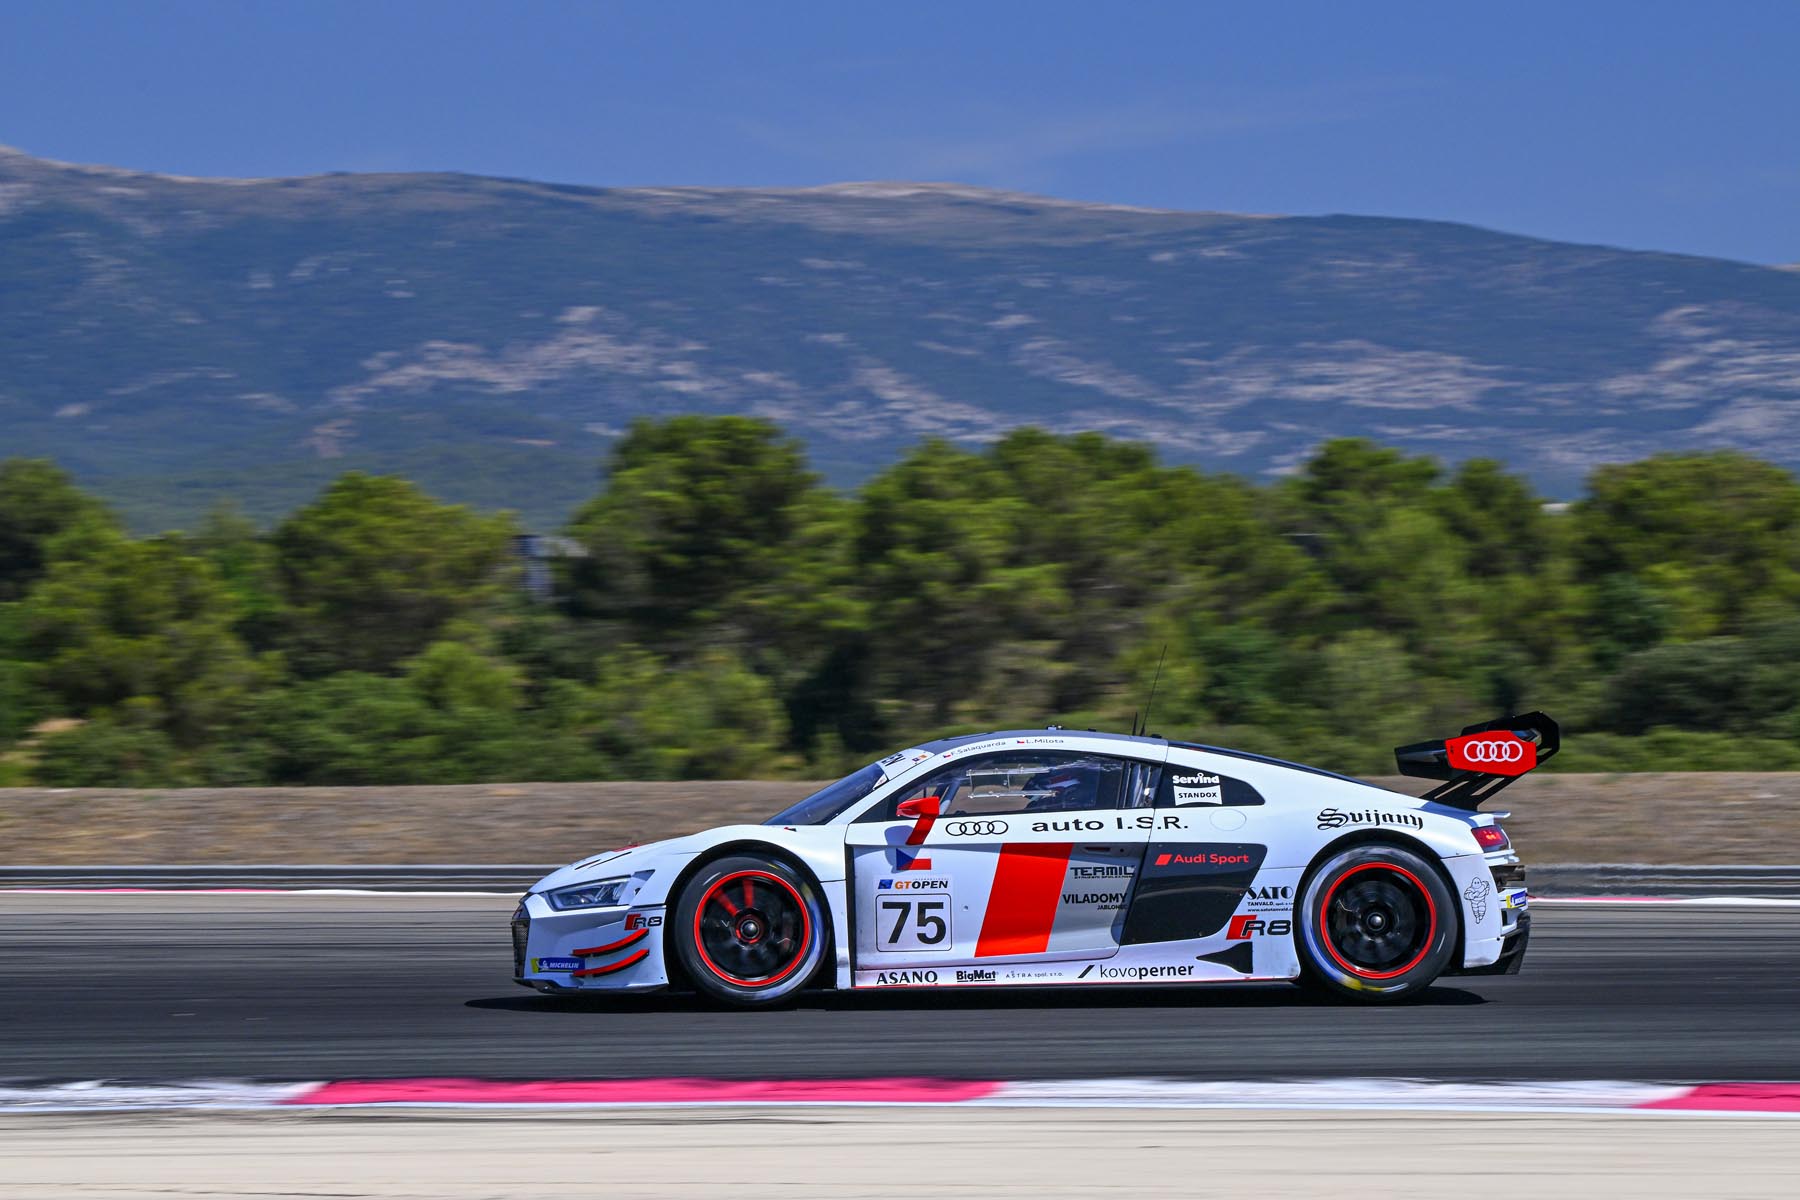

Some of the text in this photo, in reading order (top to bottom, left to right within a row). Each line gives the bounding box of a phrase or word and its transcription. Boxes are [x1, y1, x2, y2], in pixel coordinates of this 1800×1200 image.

[1172, 772, 1220, 784] Servind
[1031, 816, 1188, 832] auto I.S.R.
[1317, 808, 1423, 831] Svijany
[1173, 854, 1249, 866] Audi Sport
[1063, 893, 1128, 905] VILADOMY
[1247, 886, 1294, 900] SATO
[632, 916, 662, 928] R8
[882, 901, 947, 945] 75
[1241, 919, 1292, 937] R8
[876, 970, 938, 985] ASANO
[956, 970, 996, 982] BigMat
[1100, 964, 1194, 980] kovoperner
